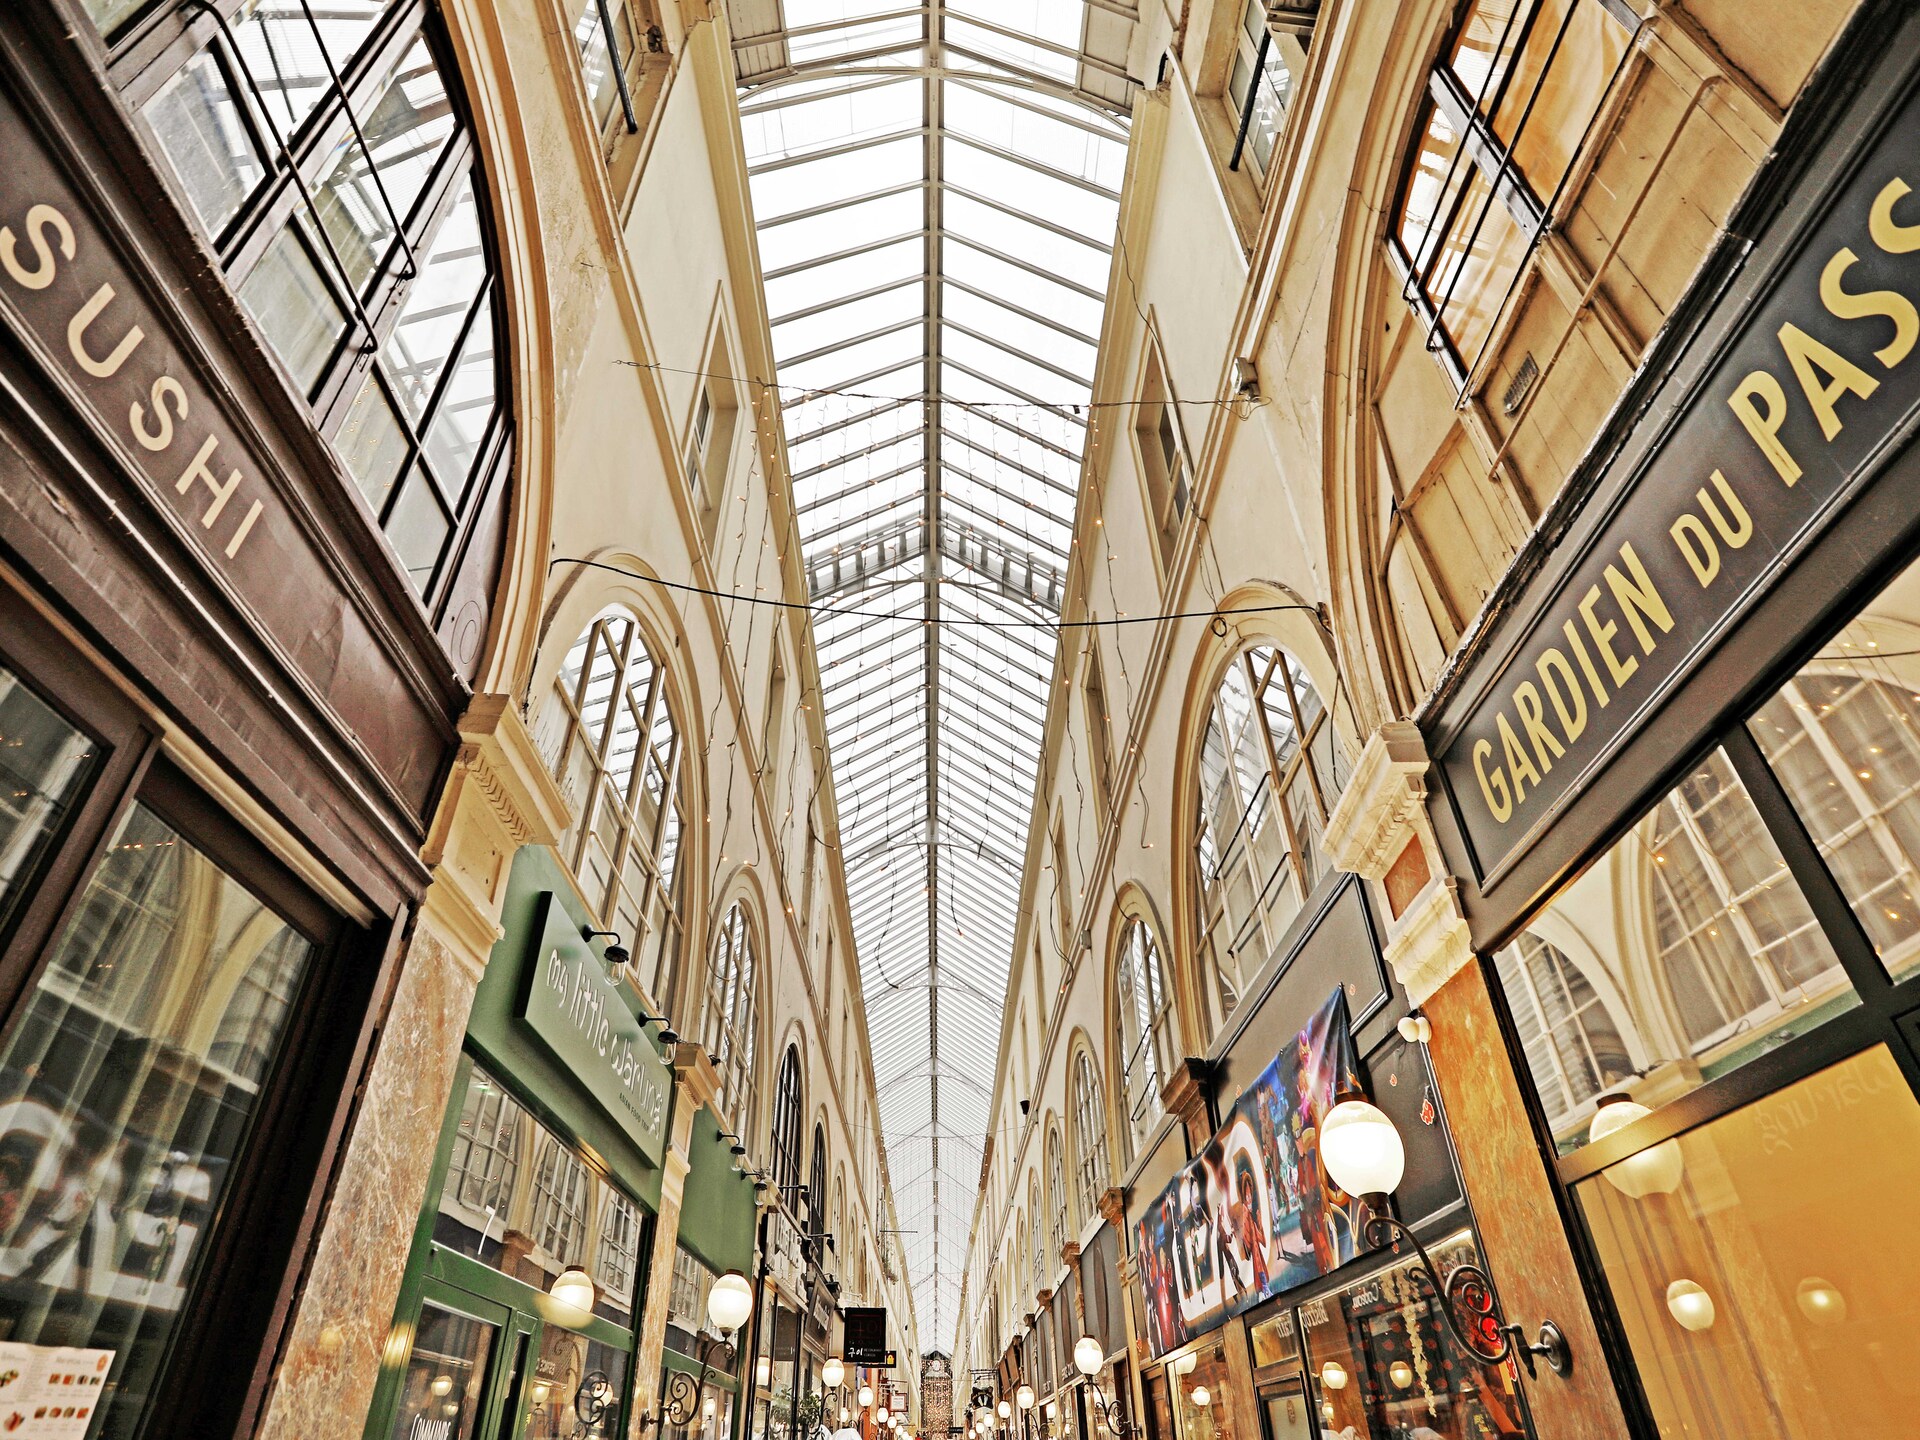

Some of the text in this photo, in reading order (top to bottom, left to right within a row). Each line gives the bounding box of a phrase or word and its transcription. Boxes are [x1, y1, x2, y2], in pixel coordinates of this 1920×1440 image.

[0, 204, 264, 559] SUSHI
[1473, 540, 1675, 823] GARDIEN
[1669, 469, 1752, 588] DU
[546, 949, 569, 1008] my
[569, 962, 610, 1057] little
